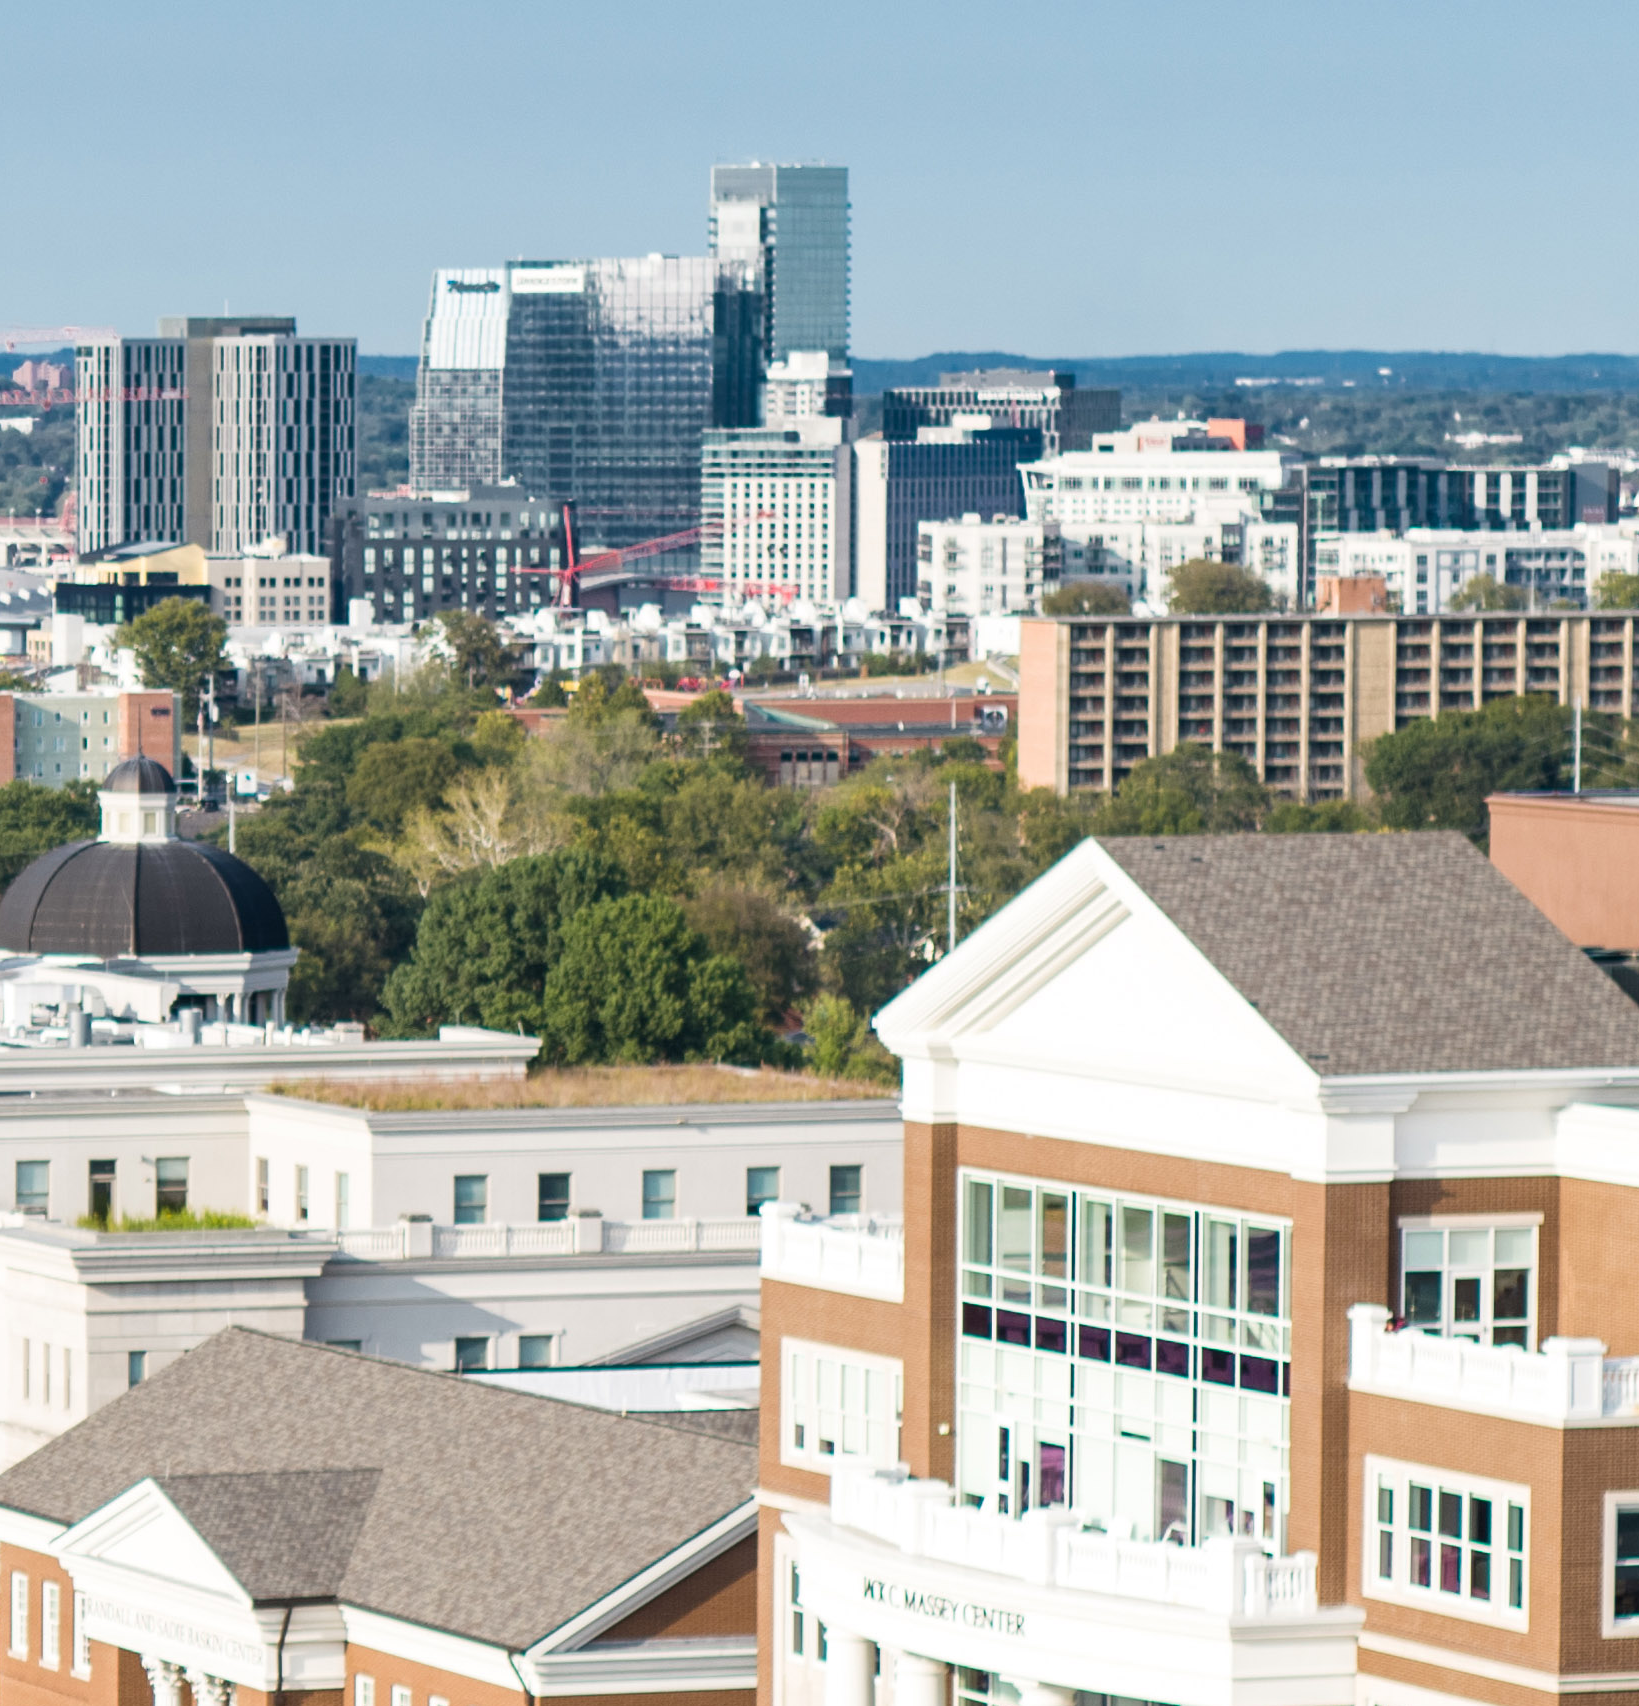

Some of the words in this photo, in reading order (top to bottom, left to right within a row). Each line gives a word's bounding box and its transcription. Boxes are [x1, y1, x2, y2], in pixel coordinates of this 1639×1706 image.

[86, 1596, 131, 1626] RANDALL
[135, 1611, 157, 1634] AND
[187, 1627, 224, 1655] BASKIN
[224, 1637, 263, 1666] CENTER
[903, 1588, 958, 1622] MASSEY
[962, 1602, 1025, 1637] CENTER
